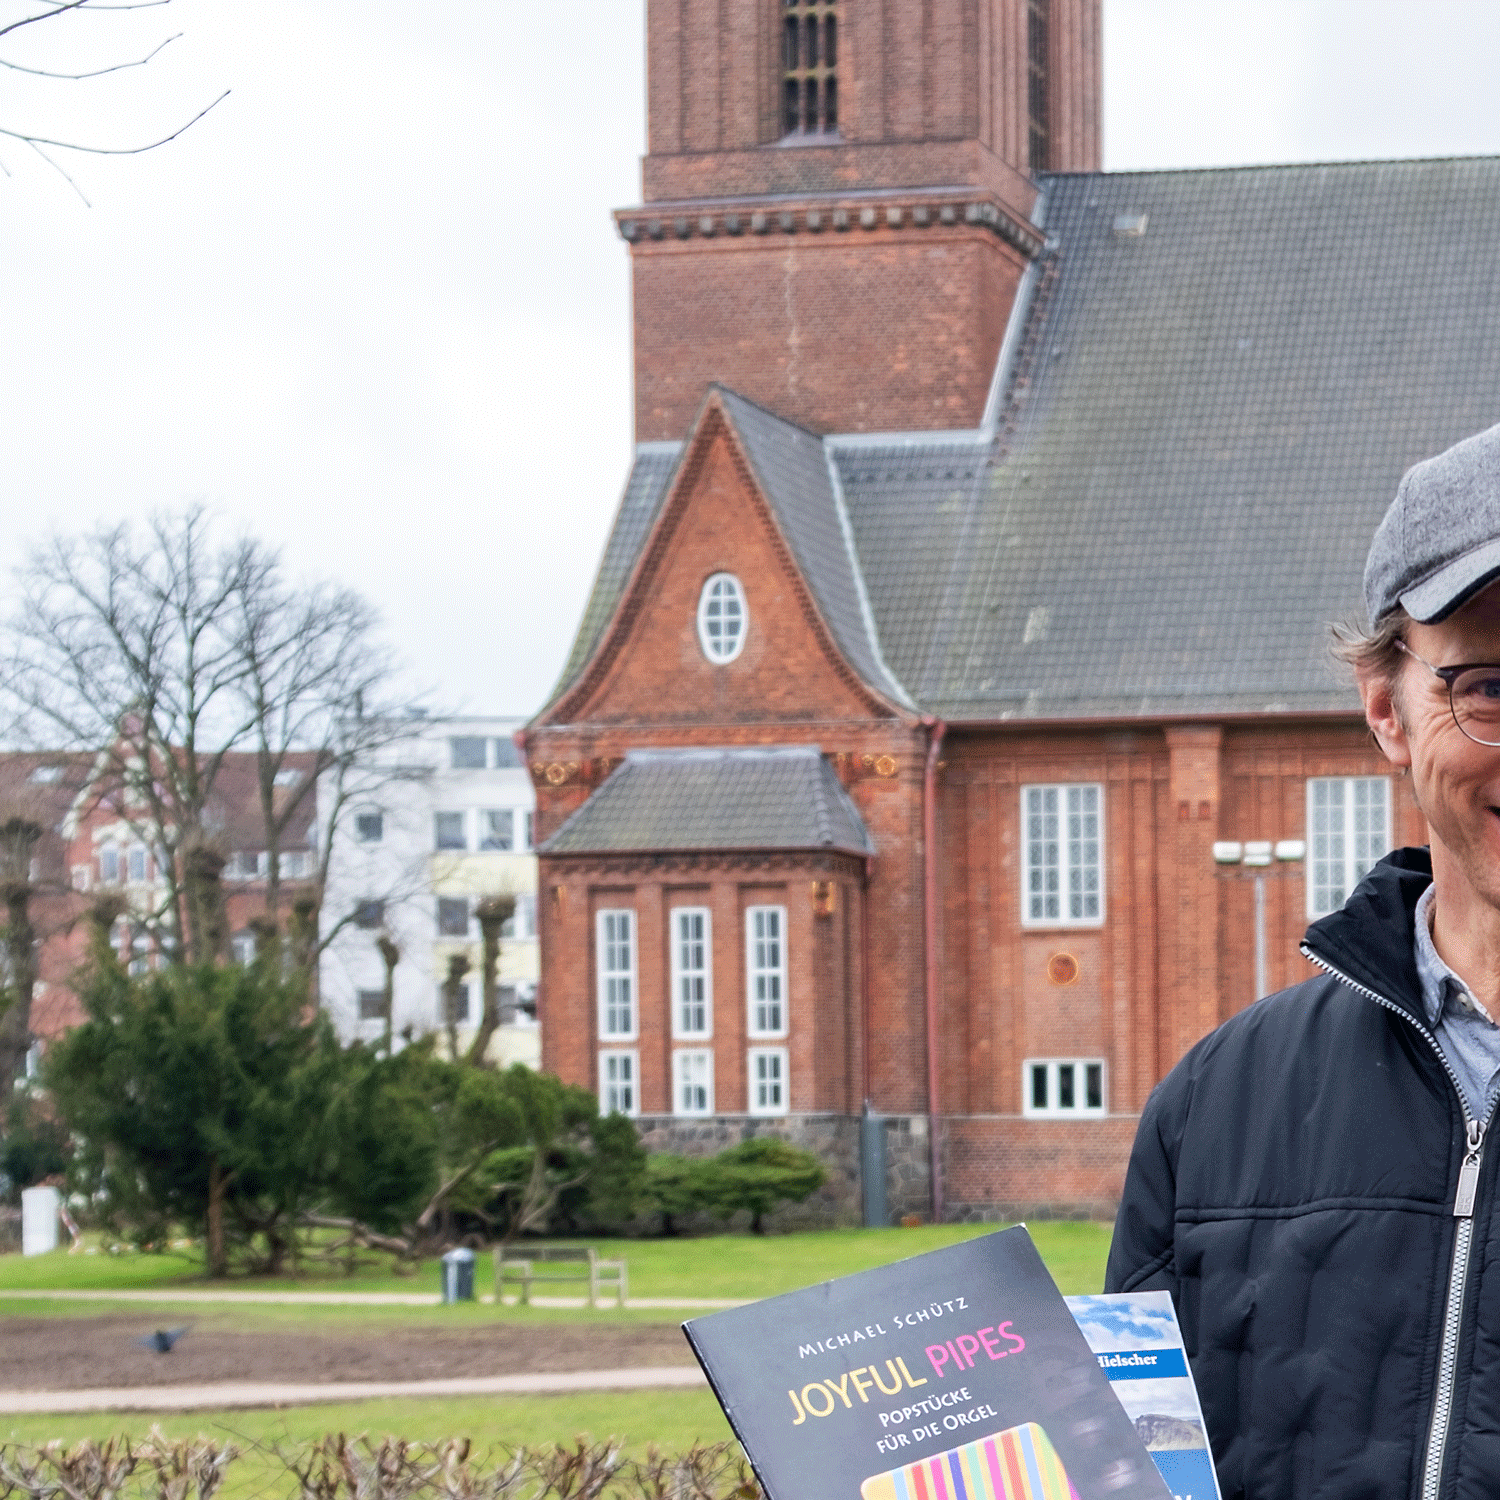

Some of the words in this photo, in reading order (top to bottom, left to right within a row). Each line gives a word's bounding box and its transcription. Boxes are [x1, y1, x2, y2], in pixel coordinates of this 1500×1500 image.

[799, 1323, 887, 1359] MICHAEL
[893, 1296, 969, 1330] SCHÜTZ
[788, 1356, 928, 1426] JOYFUL
[924, 1320, 1026, 1379] PIPES
[876, 1434, 911, 1454] FÜR
[912, 1422, 942, 1443] DIE
[942, 1404, 998, 1433] ORGEL
[879, 1386, 973, 1428] POPSTÜCKE
